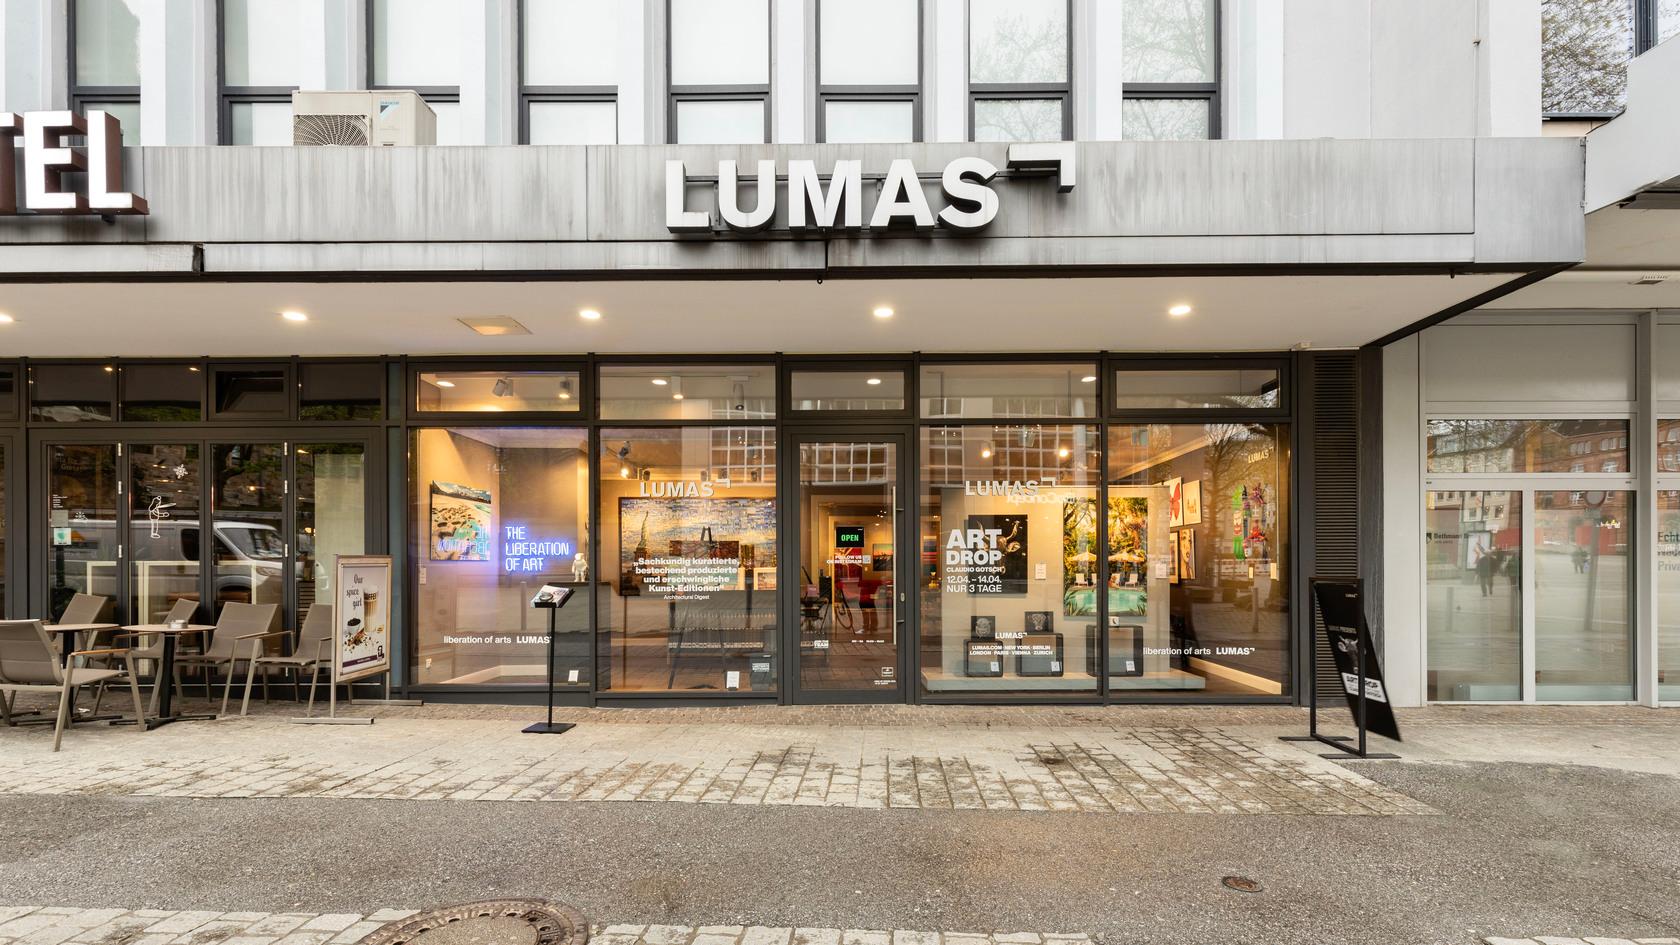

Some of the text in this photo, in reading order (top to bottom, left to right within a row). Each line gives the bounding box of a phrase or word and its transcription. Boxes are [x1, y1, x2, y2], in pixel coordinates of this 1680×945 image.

[0, 110, 140, 213] EL
[665, 156, 1000, 233] LUMAS
[1248, 450, 1269, 464] LUMAS
[640, 481, 714, 497] LUMAS
[965, 480, 1040, 496] LUMAS
[505, 526, 526, 540] THE
[841, 534, 859, 542] OPEN
[946, 529, 1002, 549] ART
[505, 542, 569, 556] LIBERATION
[505, 557, 544, 571] OF ART
[692, 557, 740, 567] kuratierte,
[946, 550, 1002, 565] DROP
[635, 567, 738, 575] bestechend produzierte
[662, 575, 730, 585] erschwingliche
[947, 575, 970, 583] 12.04.
[978, 575, 1002, 583] 14.04.
[946, 584, 1002, 593] NUR 3 TAGE
[443, 635, 550, 644] liberation of arts LUMAS
[1143, 647, 1182, 655] liberation
[1183, 647, 1192, 655] of
[1216, 647, 1250, 655] LUMAS
